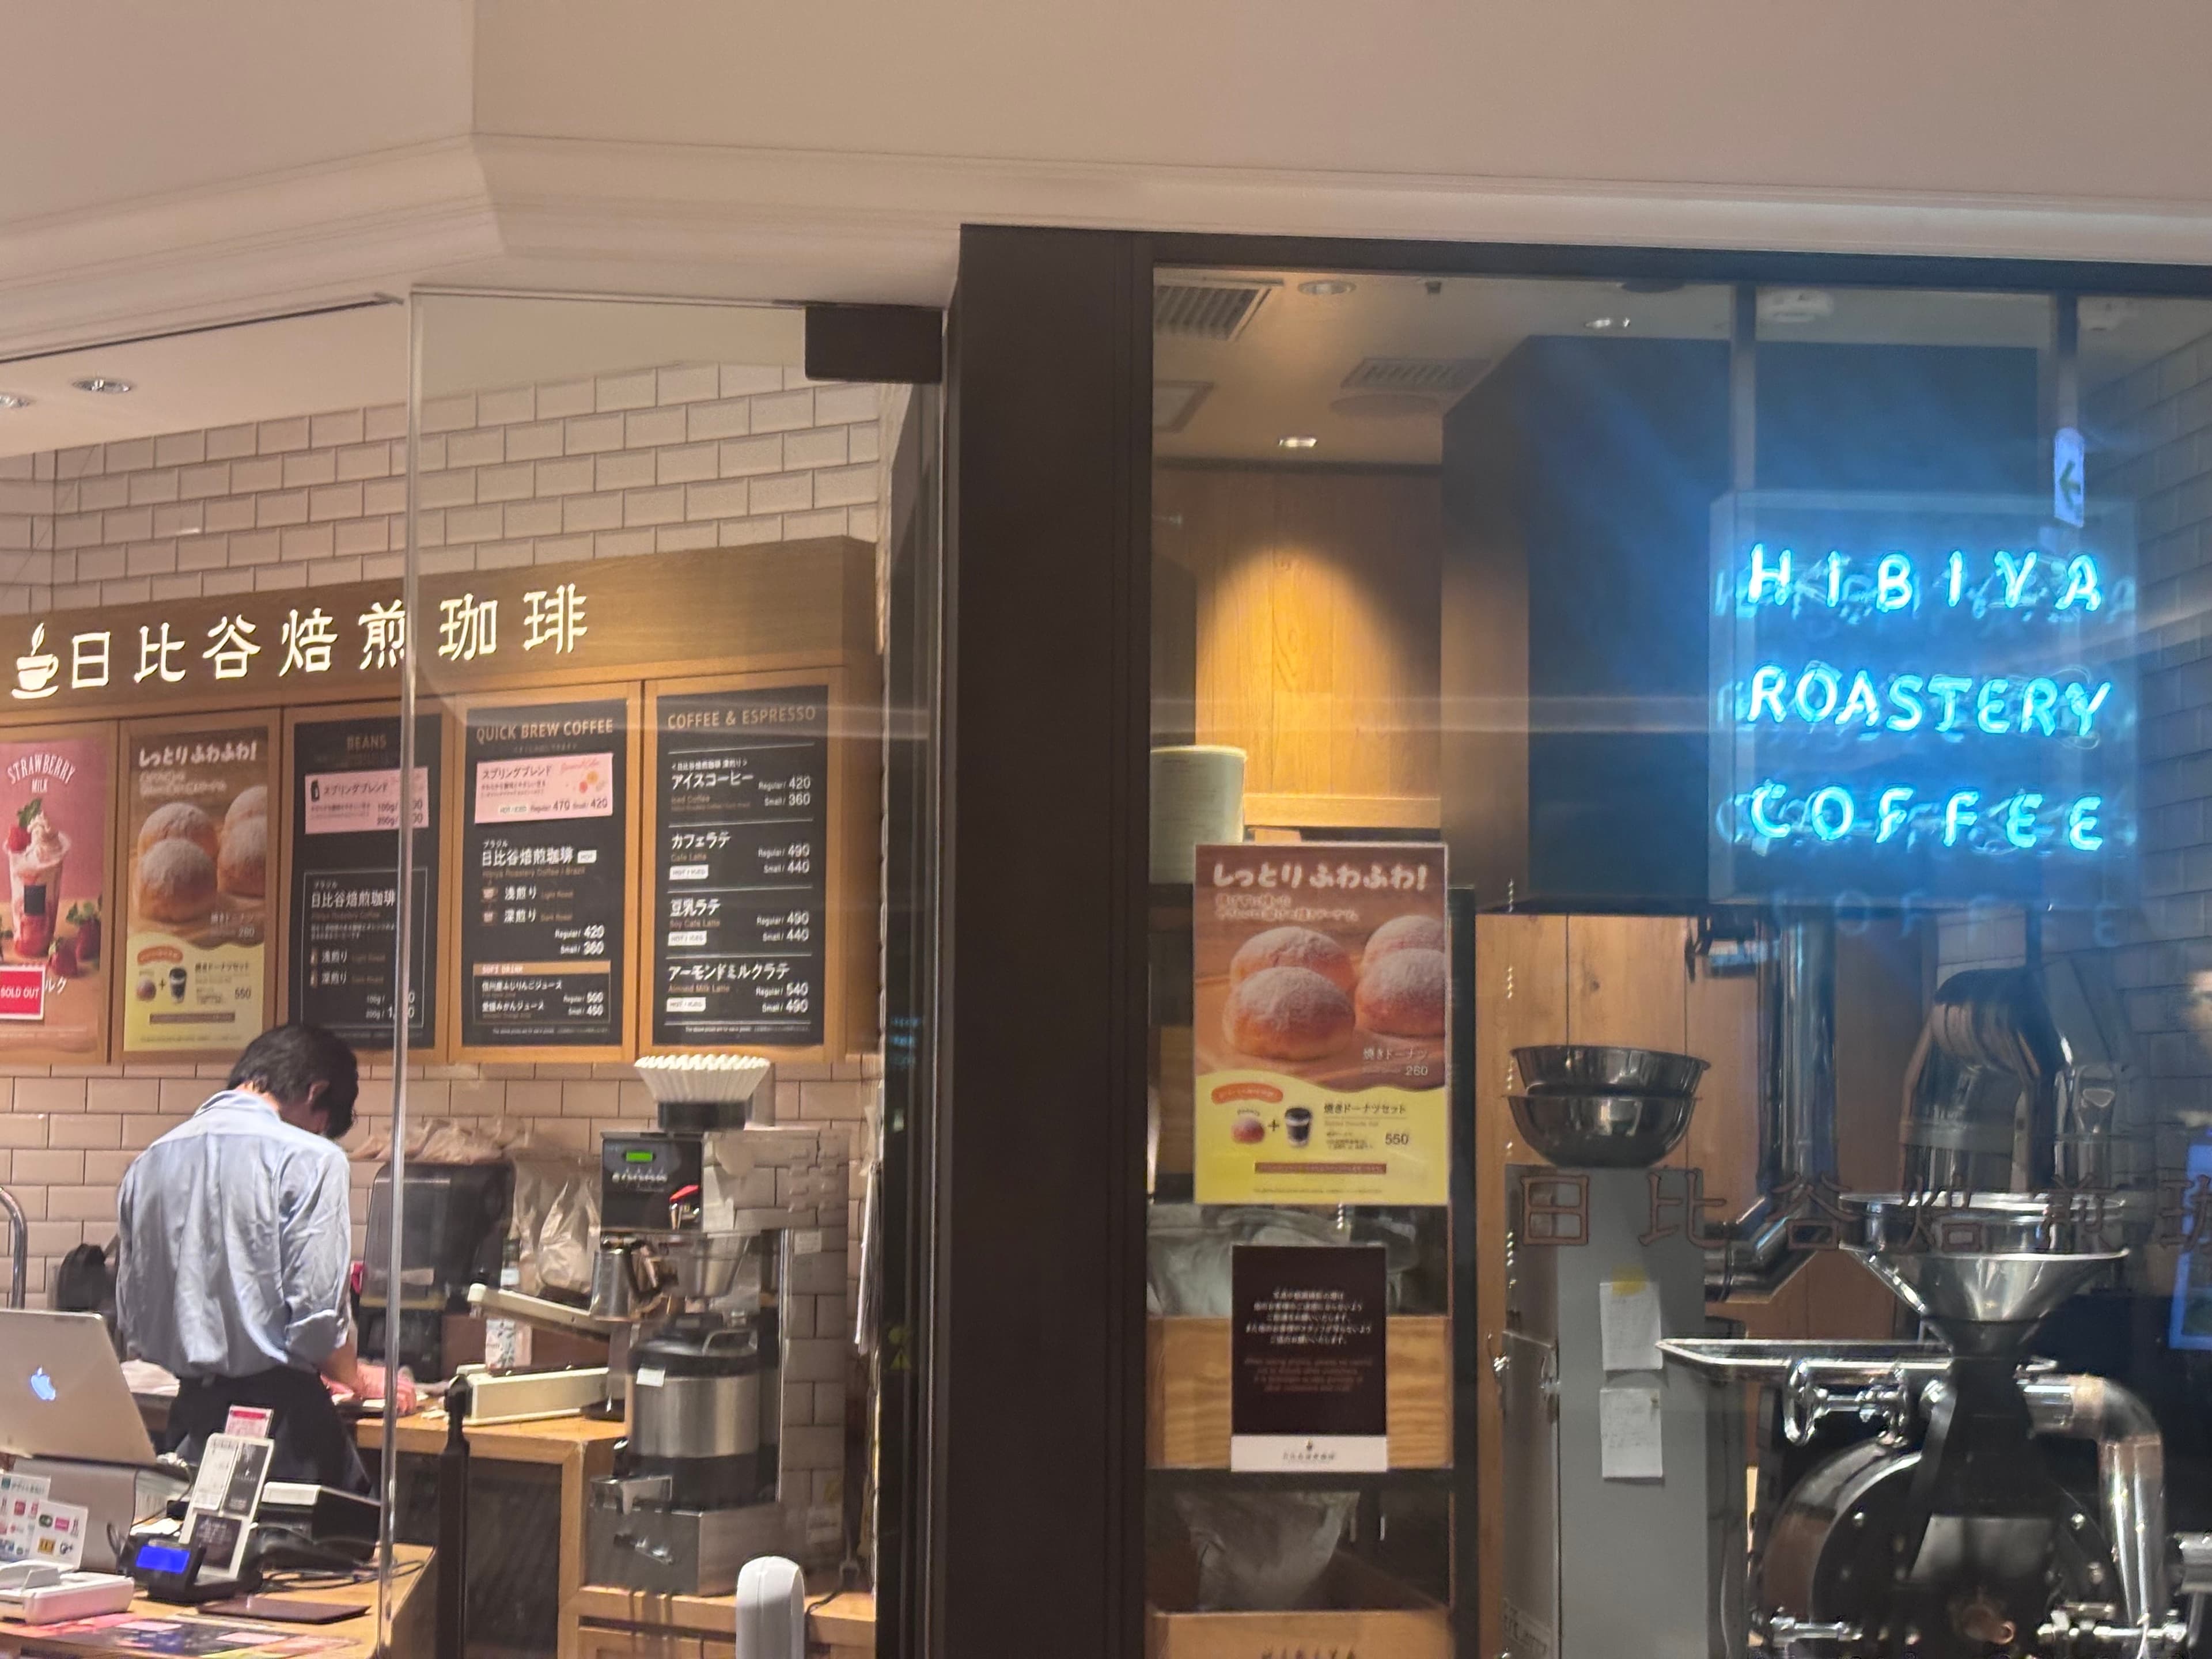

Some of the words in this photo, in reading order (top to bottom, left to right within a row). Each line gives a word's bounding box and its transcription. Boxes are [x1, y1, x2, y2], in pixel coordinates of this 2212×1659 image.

[1747, 544, 2103, 612] HIBIYA
[70, 582, 588, 690] 日比谷焙煎珈琲
[1747, 664, 2112, 737] ROASTERY
[668, 712, 719, 729] COFFEE
[726, 710, 736, 726] &
[743, 706, 816, 725] ESPRESSO
[347, 734, 387, 749] BEANS
[476, 724, 516, 745] QUICK
[521, 722, 559, 740] BREW
[563, 719, 613, 736] COFFEE
[7, 753, 75, 784] STRAWBERRY
[32, 779, 48, 793] MILK
[672, 770, 753, 790] アイスコーヒー
[789, 775, 810, 790] 420
[553, 800, 570, 811] 470
[590, 798, 608, 809] 420
[789, 792, 810, 806] 360
[1751, 782, 2104, 851] COFFEE
[672, 831, 731, 850] カフェラテ
[787, 859, 810, 874] 440
[1213, 862, 1302, 888] しっとり
[1, 986, 21, 998] SOLD
[23, 987, 40, 999] OUT
[1405, 1065, 1429, 1076] 260
